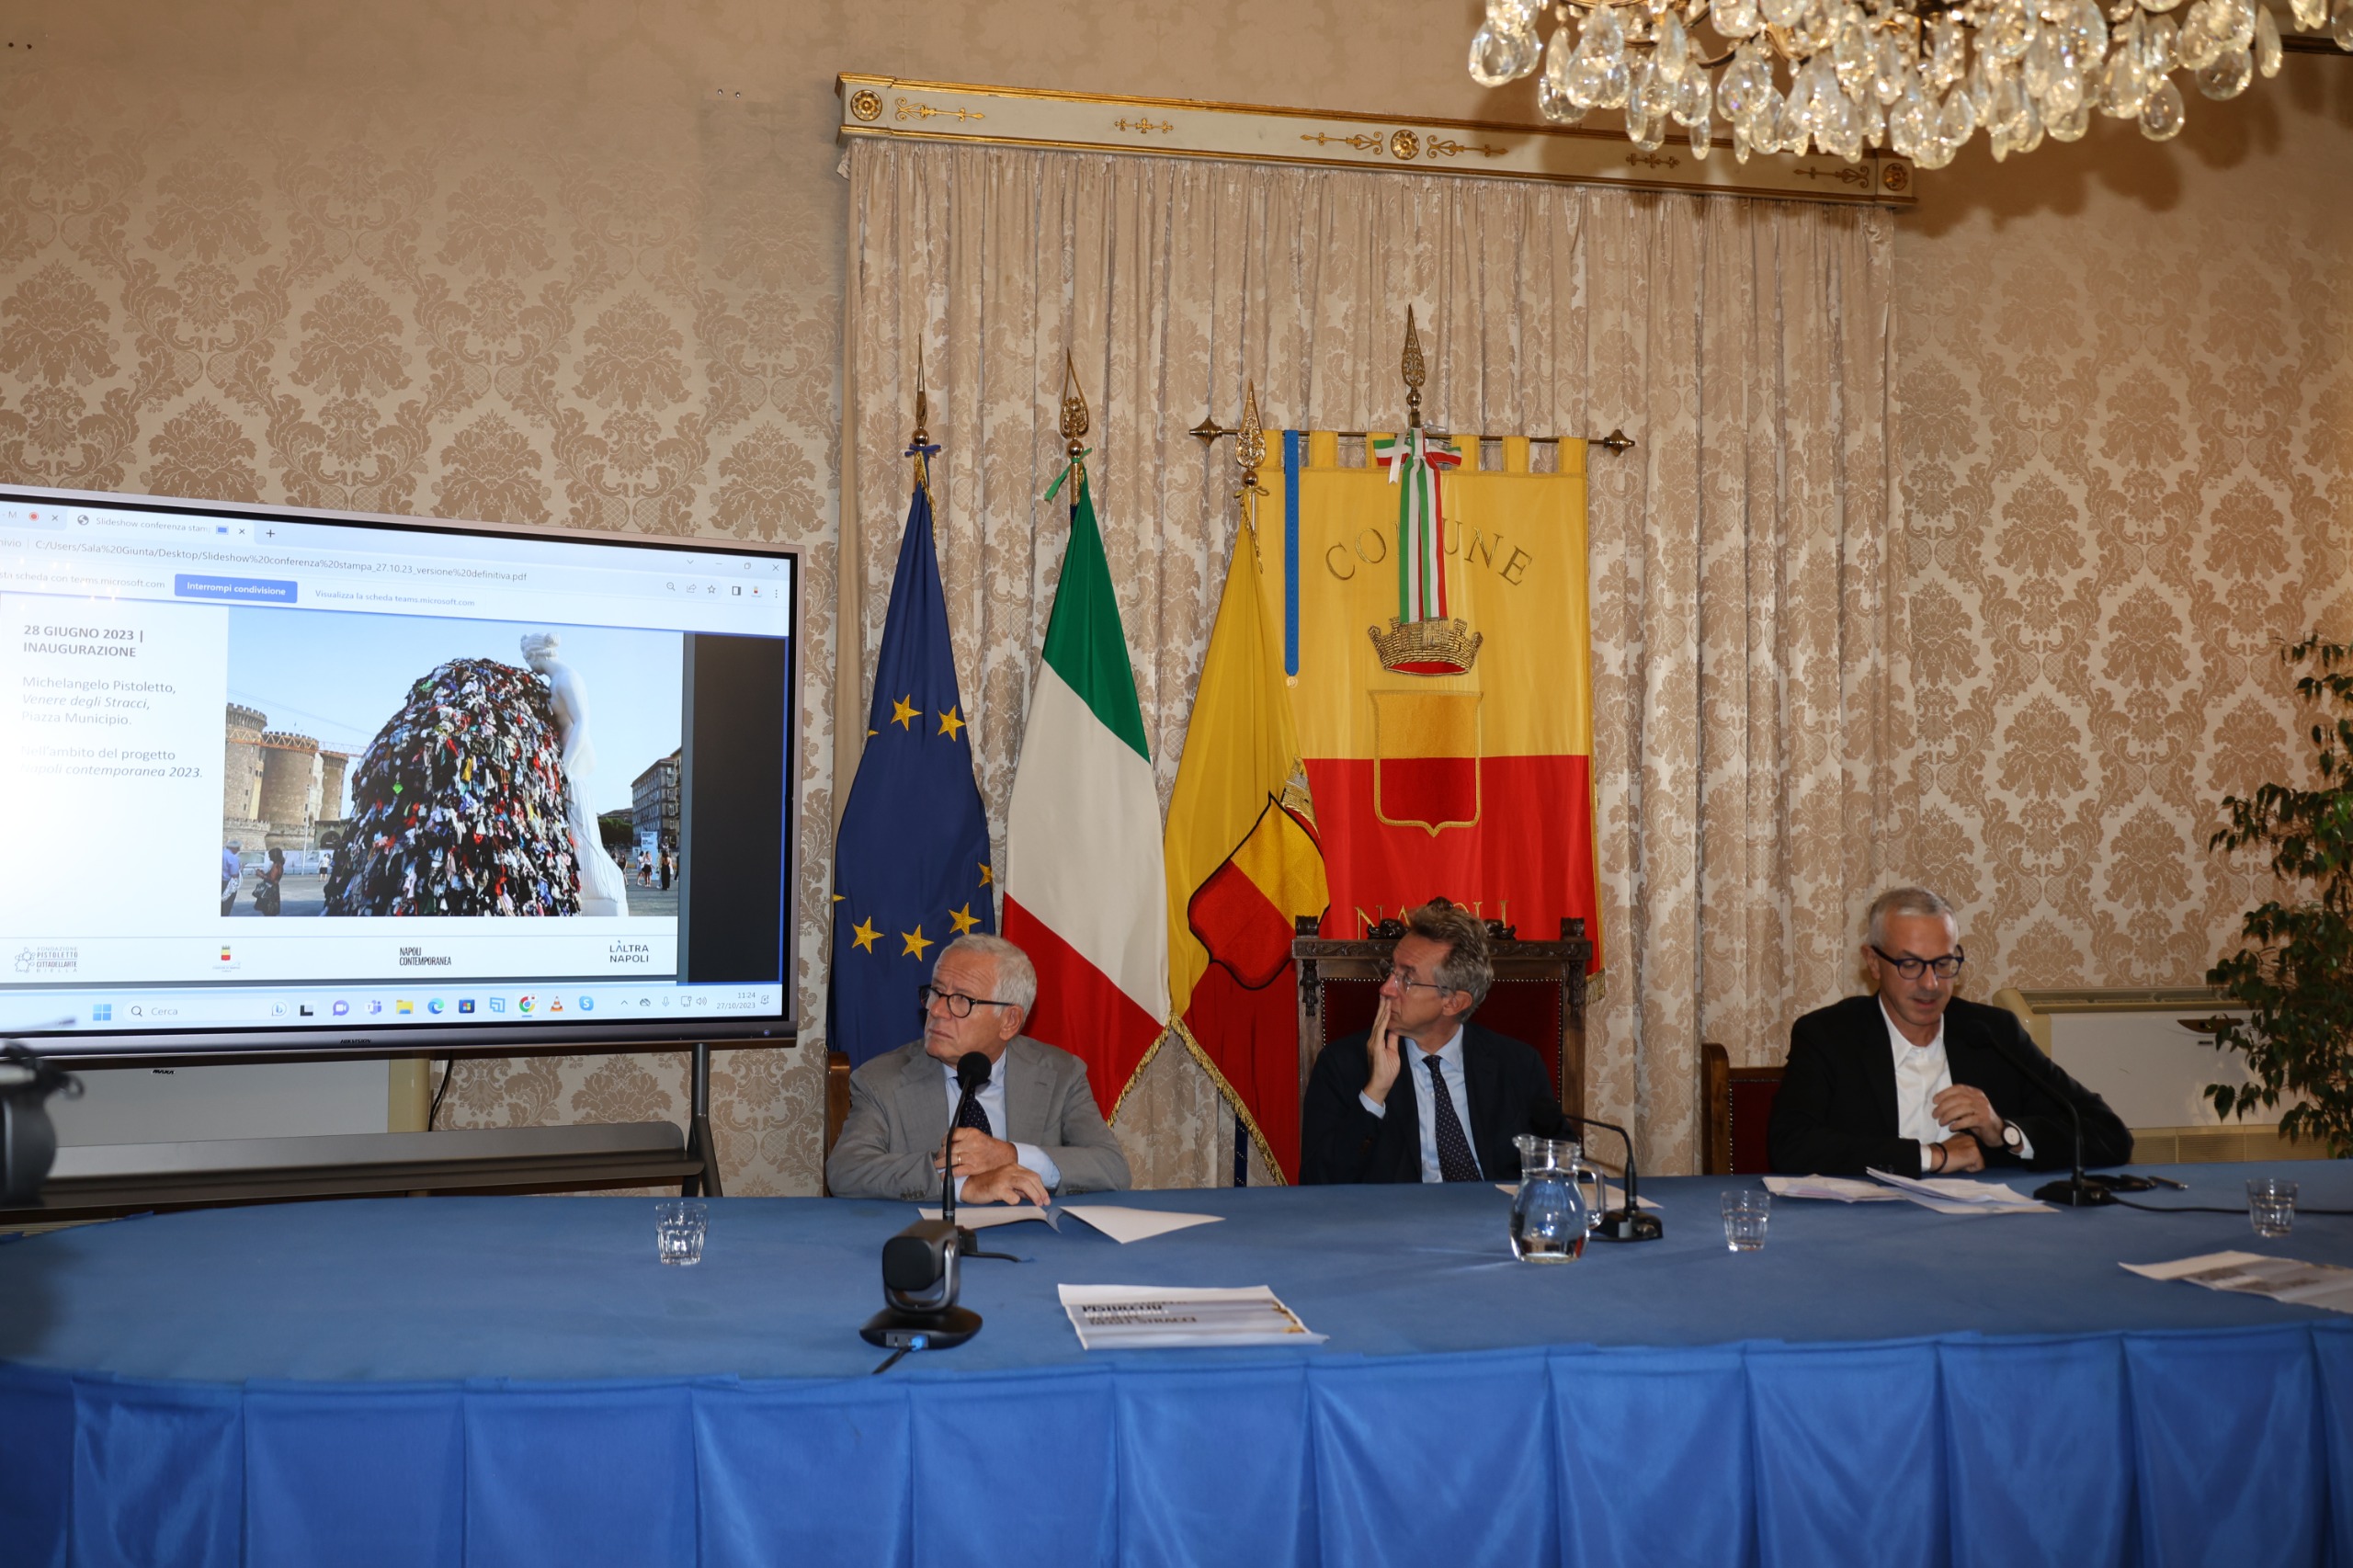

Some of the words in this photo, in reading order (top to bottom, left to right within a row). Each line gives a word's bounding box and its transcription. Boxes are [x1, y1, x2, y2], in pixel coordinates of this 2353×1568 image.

[96, 517, 139, 528] Slideshow
[141, 521, 186, 531] conferenza
[1324, 517, 1533, 586] COUNE
[16, 572, 49, 583] scheda
[51, 575, 68, 584] con
[187, 582, 232, 594] Interrompi
[233, 585, 286, 596] condivisione
[315, 589, 355, 599] Visualizza
[365, 593, 393, 602] scheda
[394, 596, 475, 608] teams.microsoft.com
[24, 624, 40, 636] 28
[43, 625, 99, 639] GIUGNO
[103, 629, 134, 641] 2023
[23, 642, 137, 658] INAUGURAZIONE
[22, 676, 109, 691] Michelangelo
[113, 680, 176, 695] Pistoletto,
[22, 694, 67, 706] Venere
[70, 694, 102, 710] degli
[104, 697, 151, 710] Stracci,
[21, 710, 61, 723] Piazza
[65, 712, 132, 726] Municipio.
[98, 747, 118, 759] del
[121, 749, 176, 762] progetto
[66, 766, 165, 778] contemporanea
[169, 766, 203, 778] 2023.
[399, 947, 422, 957] NAPOLI
[609, 954, 649, 963] NAPOLI
[399, 956, 451, 966] CONTEMPORANEA
[151, 1006, 178, 1017] Cerca
[716, 1002, 756, 1010] 27/10/2023
